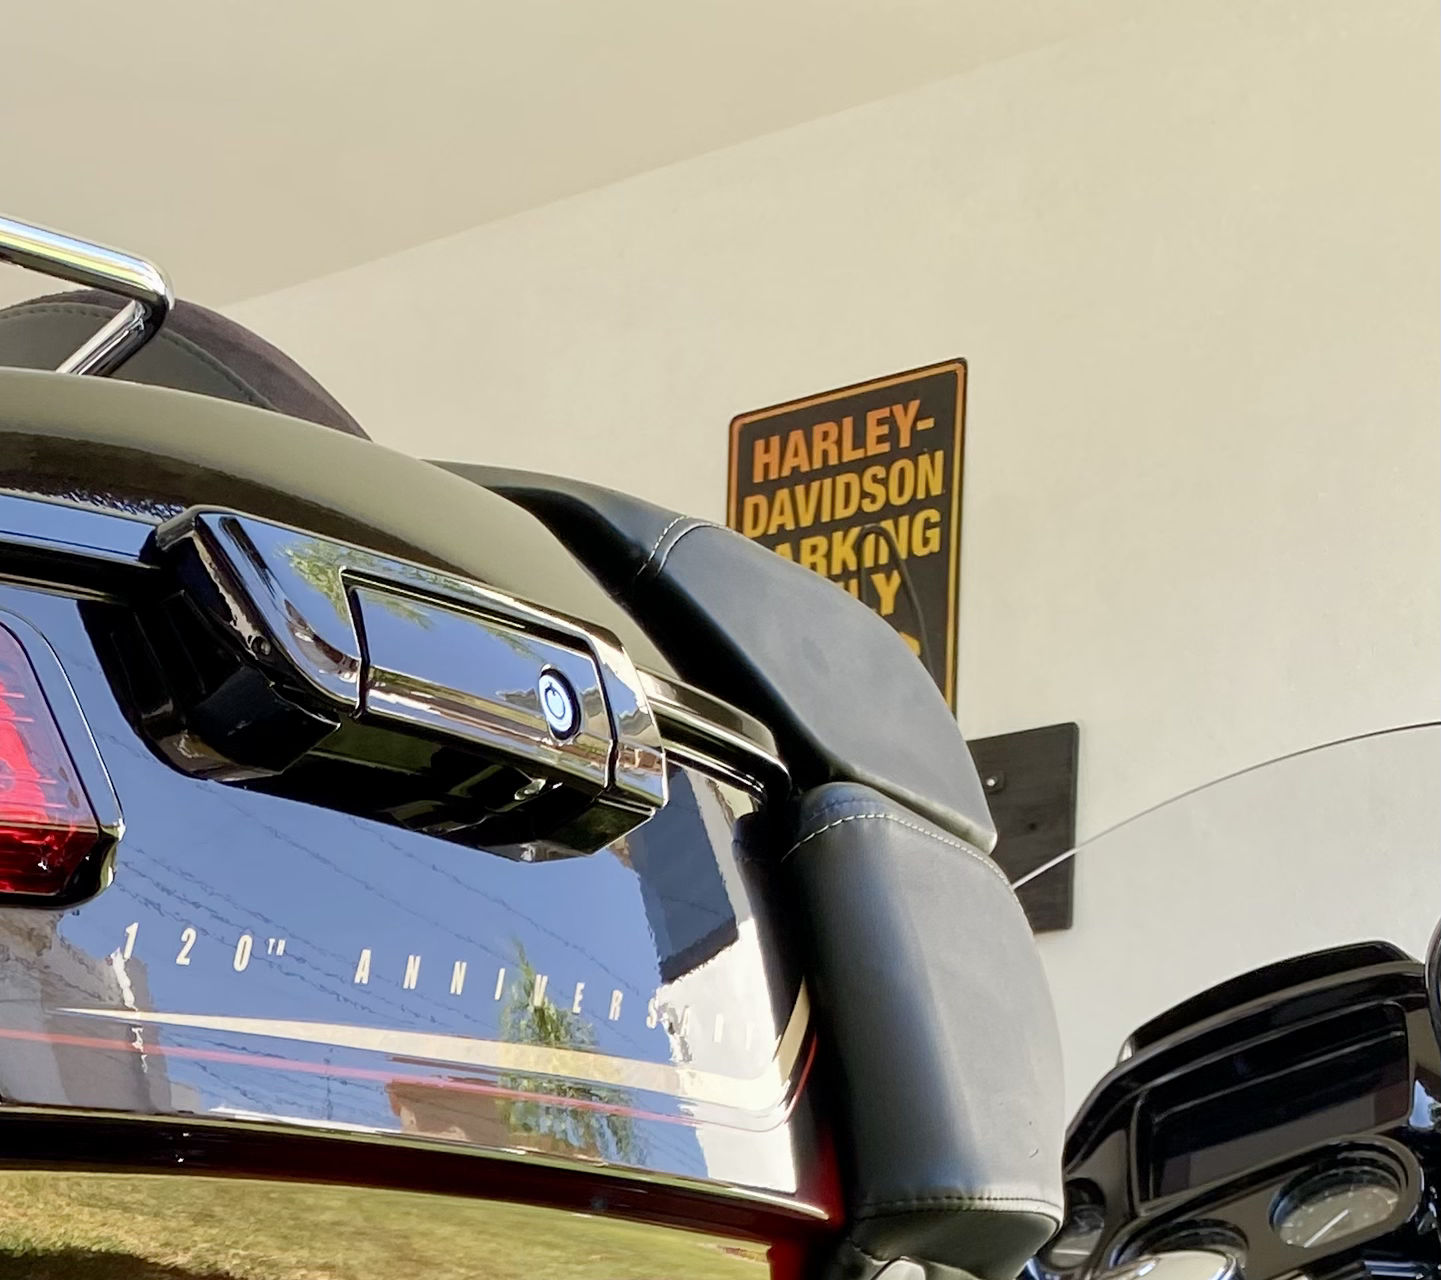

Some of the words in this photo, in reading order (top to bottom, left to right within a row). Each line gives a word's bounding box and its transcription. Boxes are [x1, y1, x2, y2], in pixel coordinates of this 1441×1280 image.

[752, 400, 935, 483] HARLEY-
[742, 450, 945, 539] DAVIDSON
[773, 508, 942, 578] RKING
